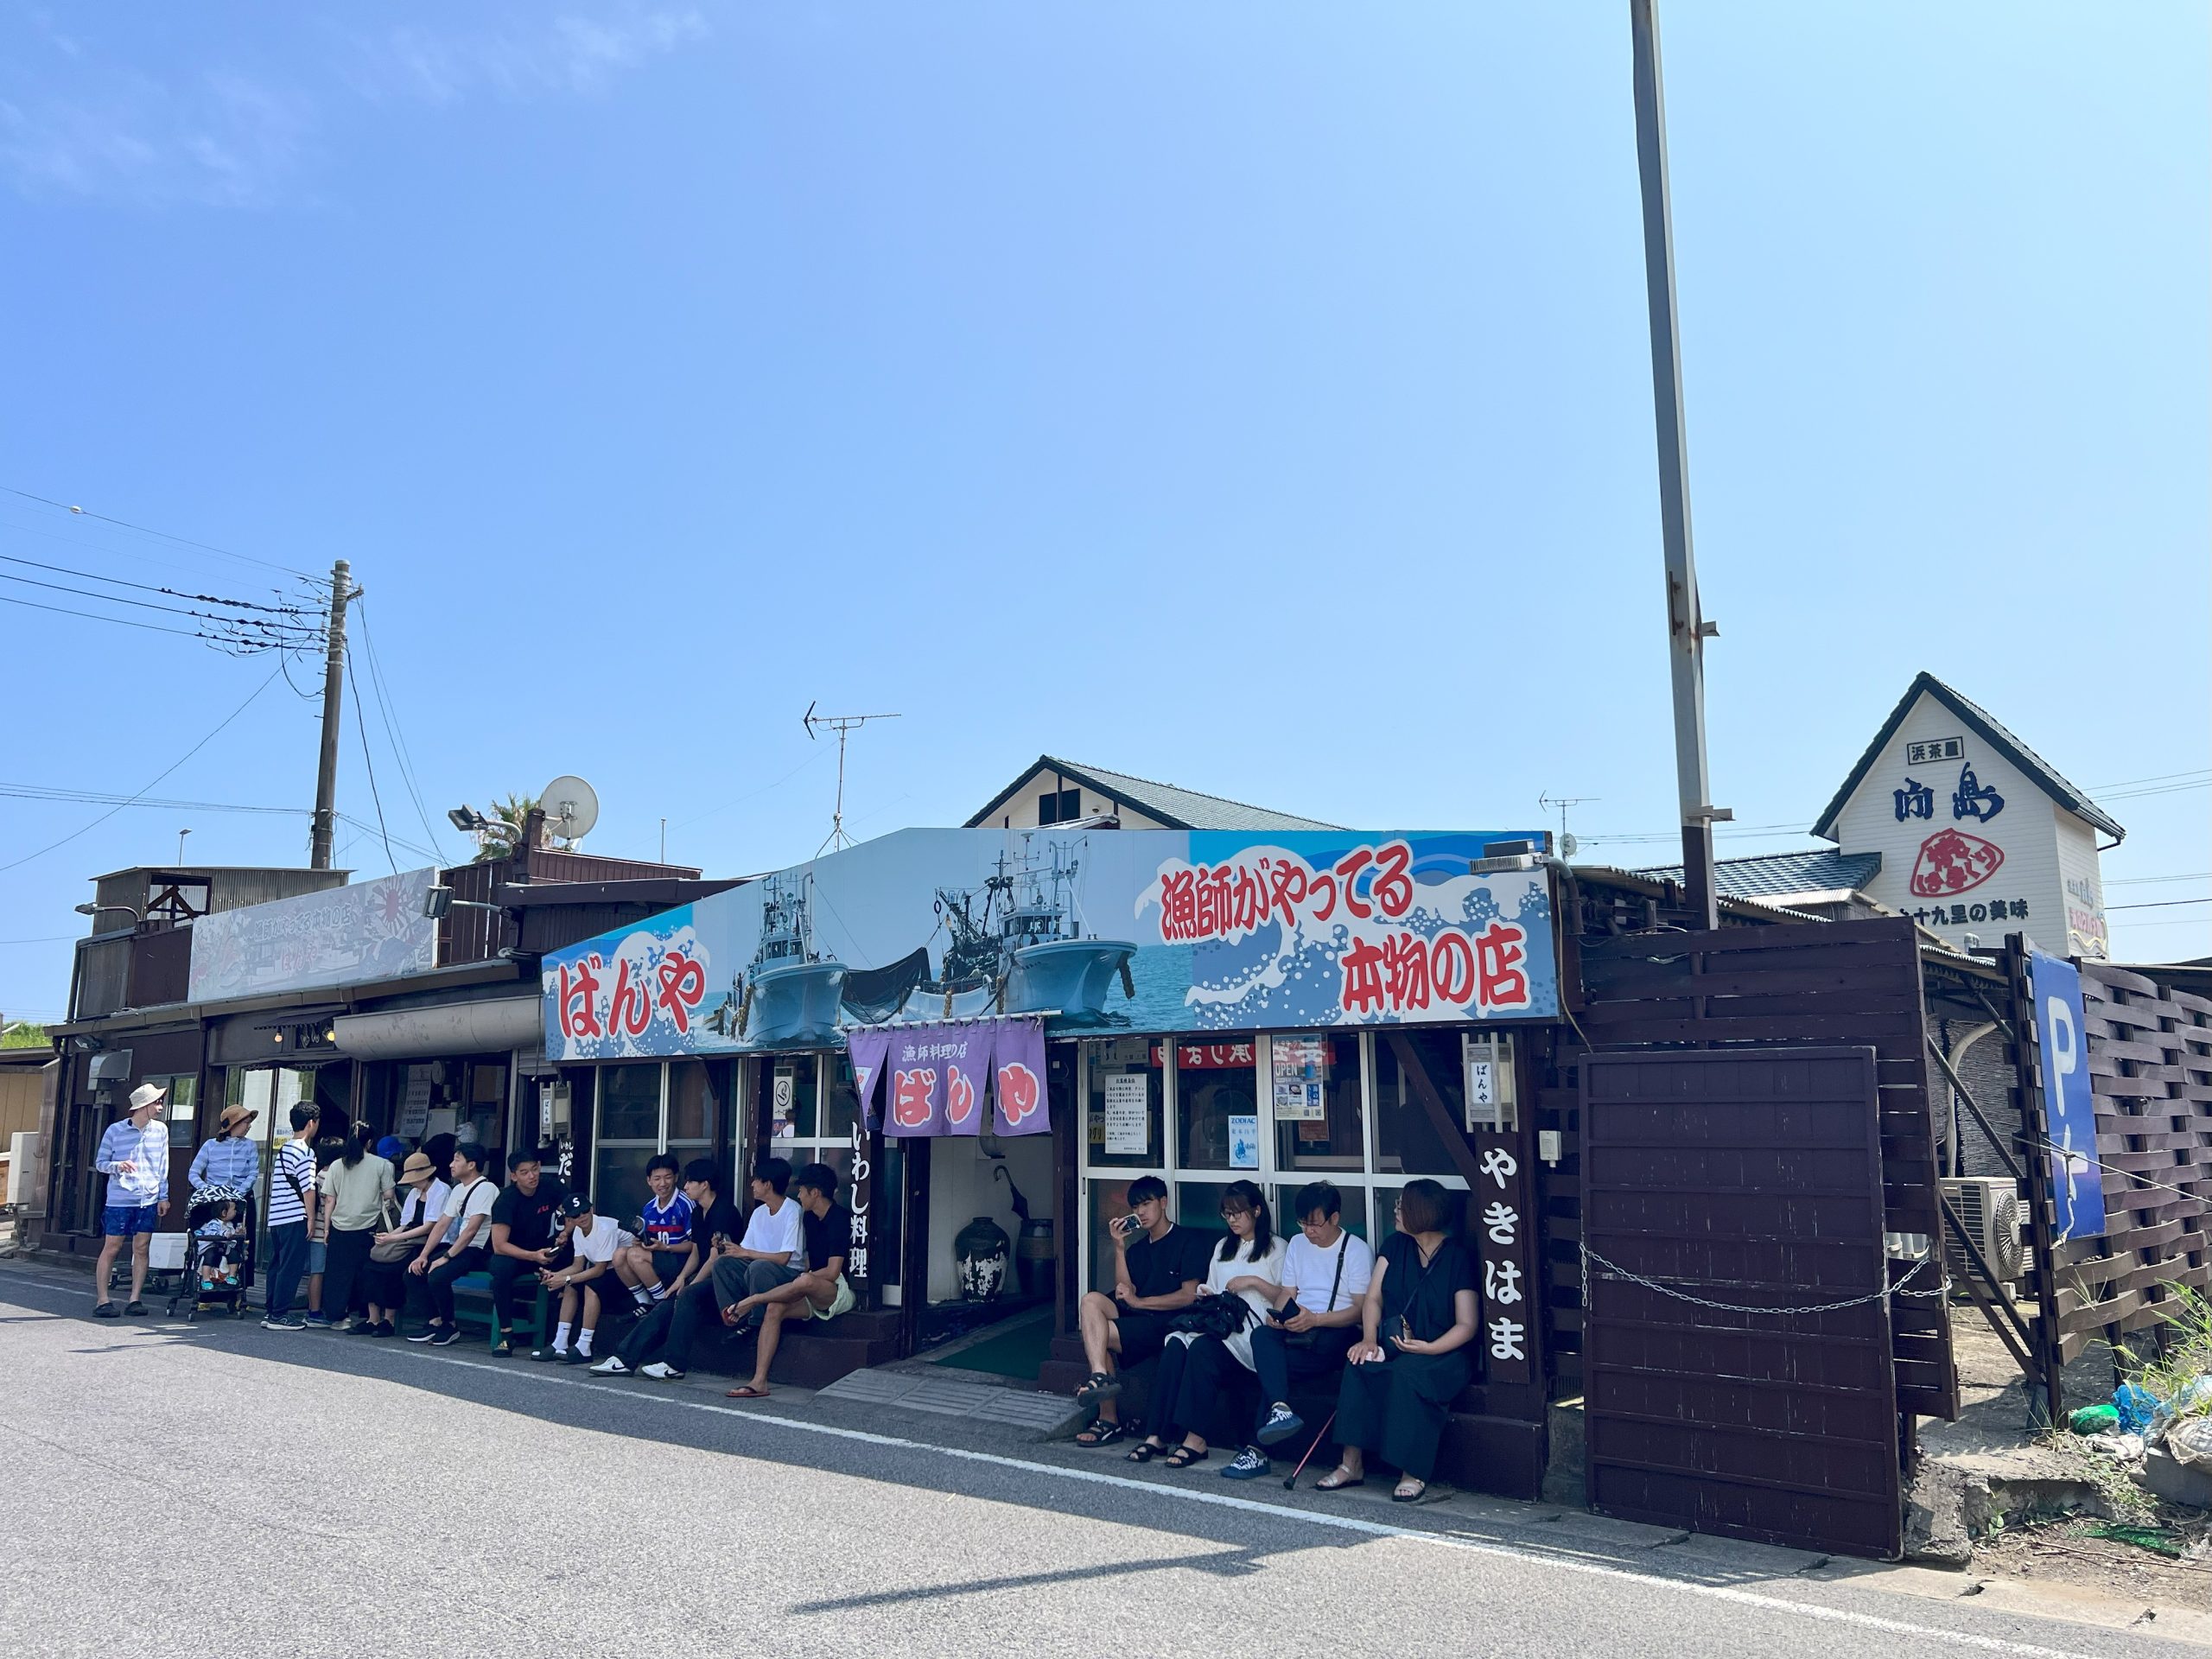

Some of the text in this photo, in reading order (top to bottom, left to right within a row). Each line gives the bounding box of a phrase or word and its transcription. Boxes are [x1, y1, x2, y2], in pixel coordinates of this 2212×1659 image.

[1911, 741, 1959, 760] 浜茶屋
[1893, 761, 2005, 823] 向島
[1160, 844, 1413, 941] 漁師がやってる
[1899, 899, 2029, 926] 十九里の美味
[560, 952, 705, 1038] ばんや
[1341, 924, 1527, 1014] 本物の店
[1274, 1062, 1298, 1077] OPEN
[1477, 1065, 1488, 1103] ばんや
[2047, 995, 2077, 1117] P
[893, 1063, 1039, 1127] ばんや
[560, 1141, 574, 1151] いわし
[573, 1197, 581, 1208] S
[849, 1122, 871, 1277] いわし料理
[658, 1230, 670, 1245] 10
[1479, 1147, 1526, 1360] やきはま
